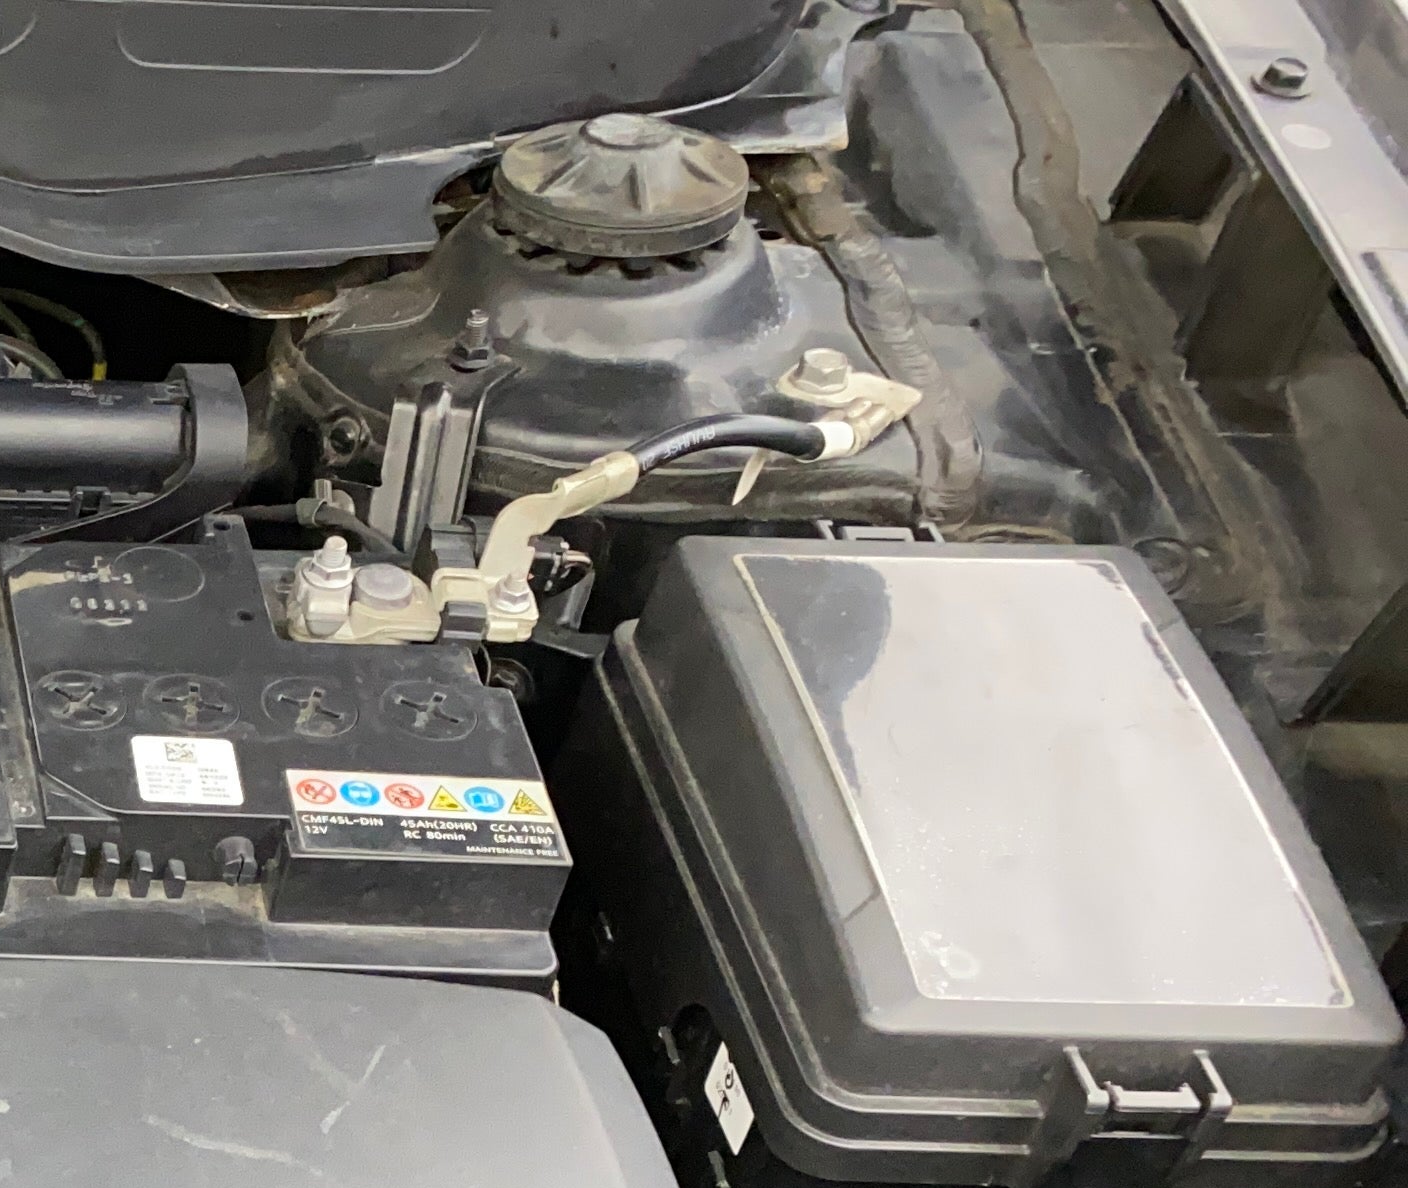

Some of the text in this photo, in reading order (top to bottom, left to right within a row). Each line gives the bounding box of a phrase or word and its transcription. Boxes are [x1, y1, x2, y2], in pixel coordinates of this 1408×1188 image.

[305, 825, 553, 846] 12V RC 80min (SAE/EN)
[400, 819, 477, 832] 45Ah(20HR)
[490, 823, 517, 833] CCA
[521, 823, 555, 835] 410A
